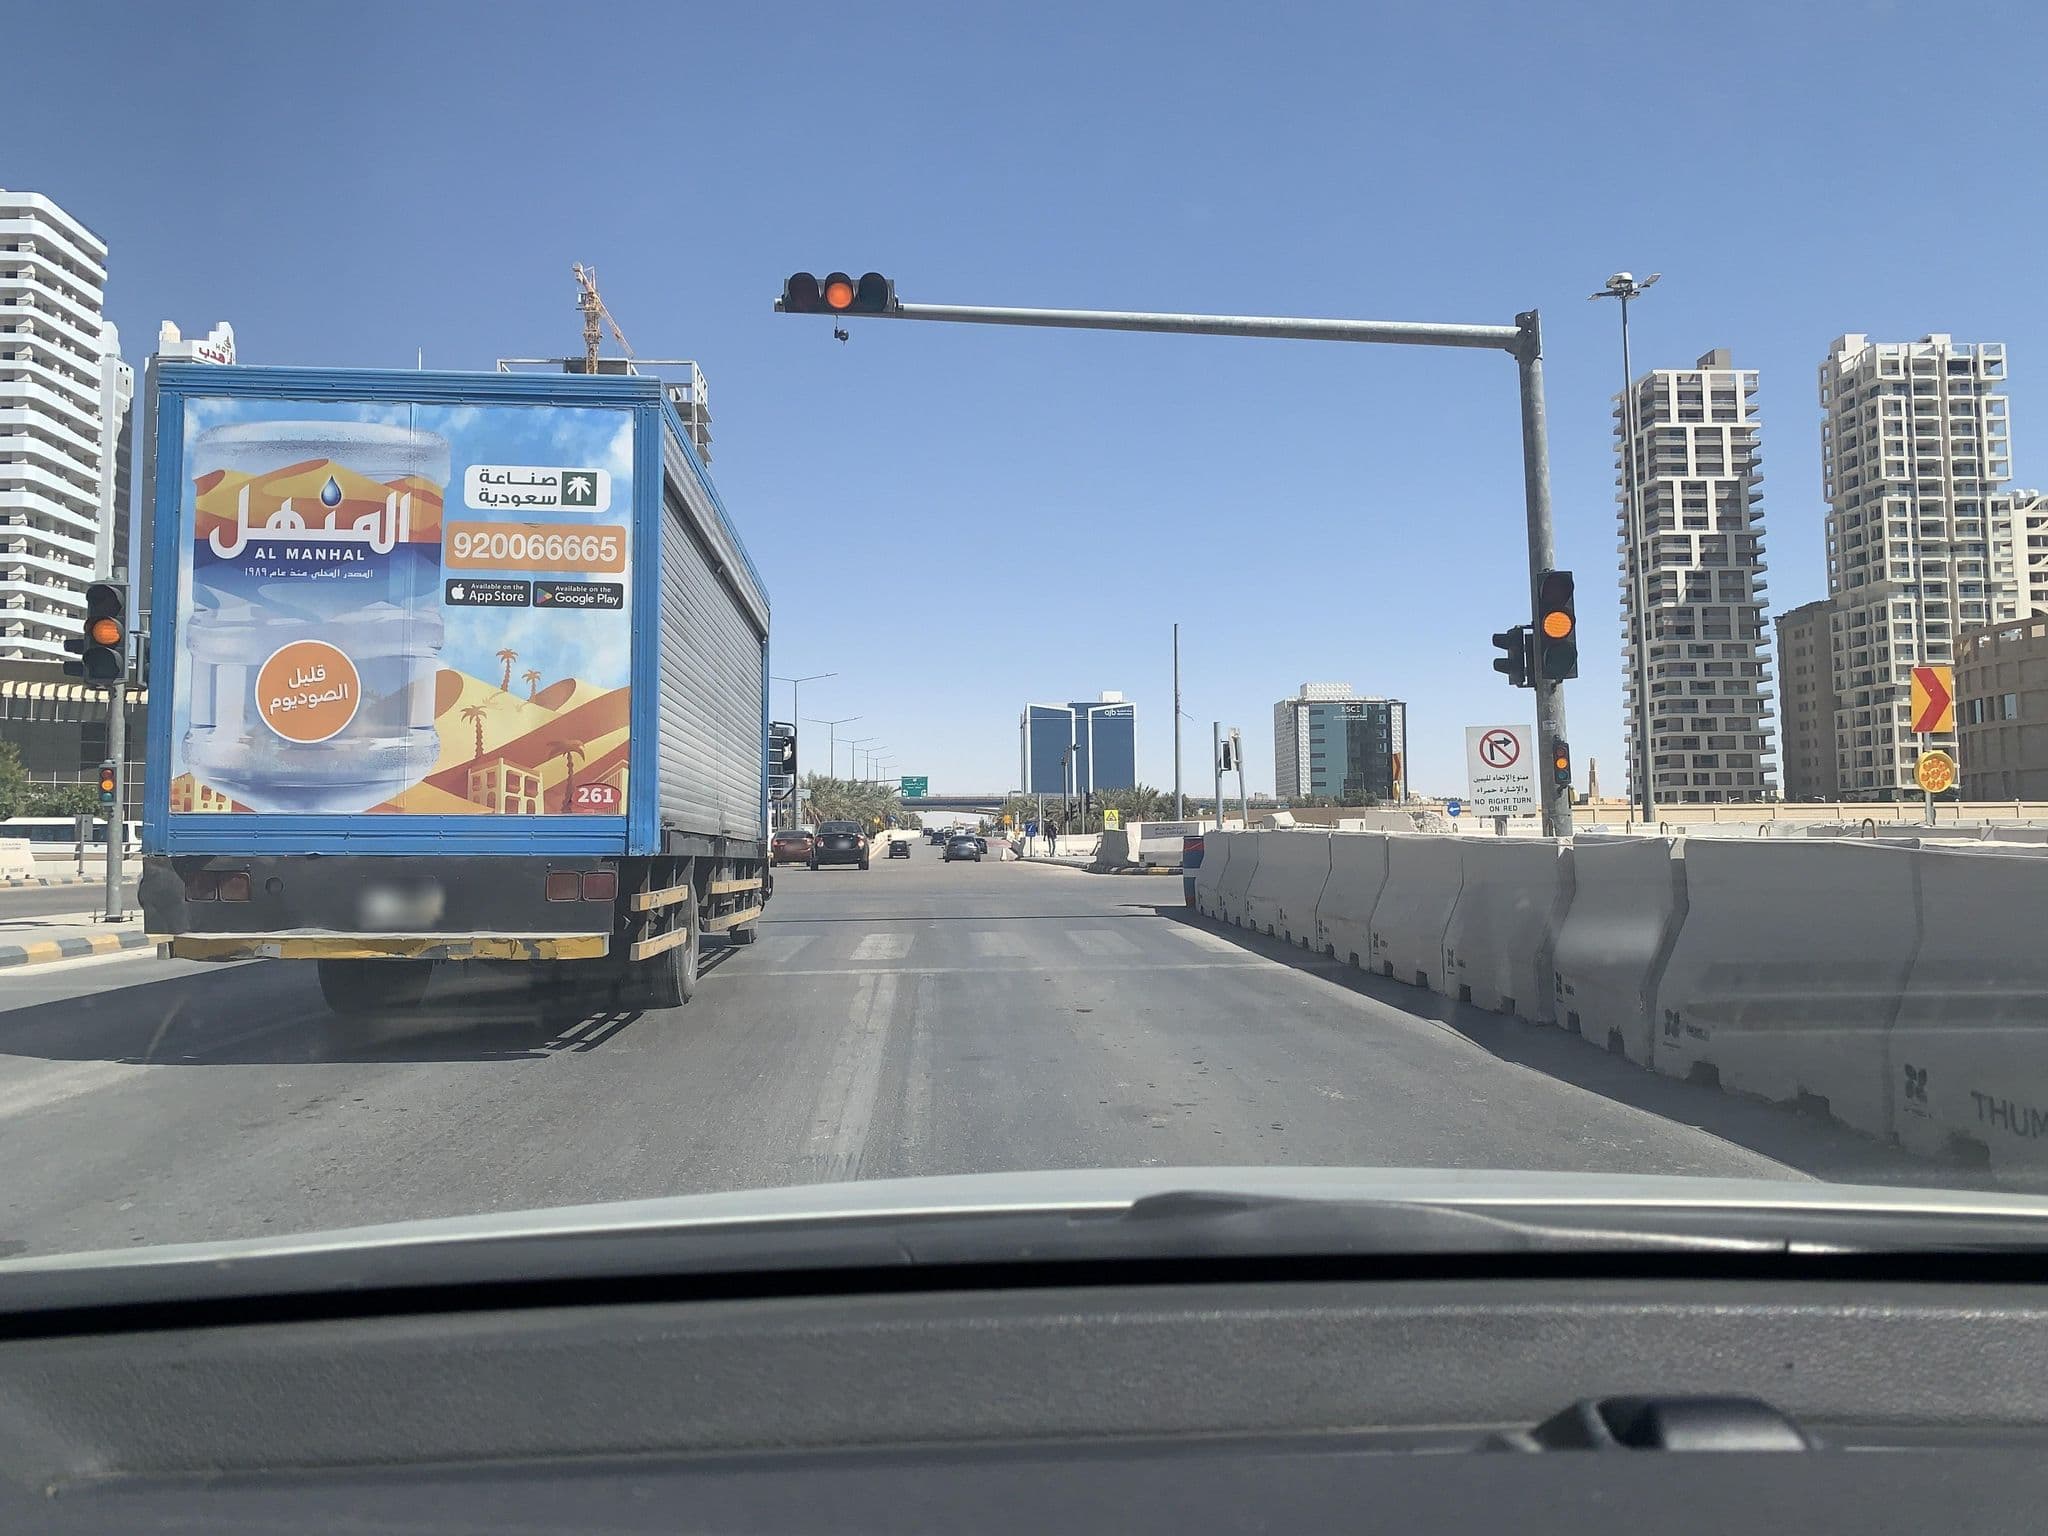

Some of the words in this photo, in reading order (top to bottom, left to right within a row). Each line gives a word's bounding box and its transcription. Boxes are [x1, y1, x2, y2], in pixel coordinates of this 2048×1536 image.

[479, 468, 557, 486] صناعة
[478, 487, 557, 507] سعودية
[209, 483, 411, 560] المنهل
[254, 547, 277, 560] AL
[285, 548, 365, 561] MANHAL
[453, 532, 618, 562] 920066665
[269, 567, 287, 578] عام
[289, 567, 308, 577] منذ
[310, 568, 340, 580] المحلي
[343, 569, 373, 579] المصدر
[471, 583, 501, 591] Available
[514, 583, 524, 591] the
[469, 590, 493, 603] App
[494, 590, 525, 602] Store
[554, 592, 595, 606] Google
[597, 593, 620, 606] Play
[288, 663, 326, 688] قليل
[269, 683, 348, 715] الصوديوم
[577, 787, 614, 803] 261
[1488, 797, 1510, 805] RIGHT
[1512, 796, 1532, 804] TURN
